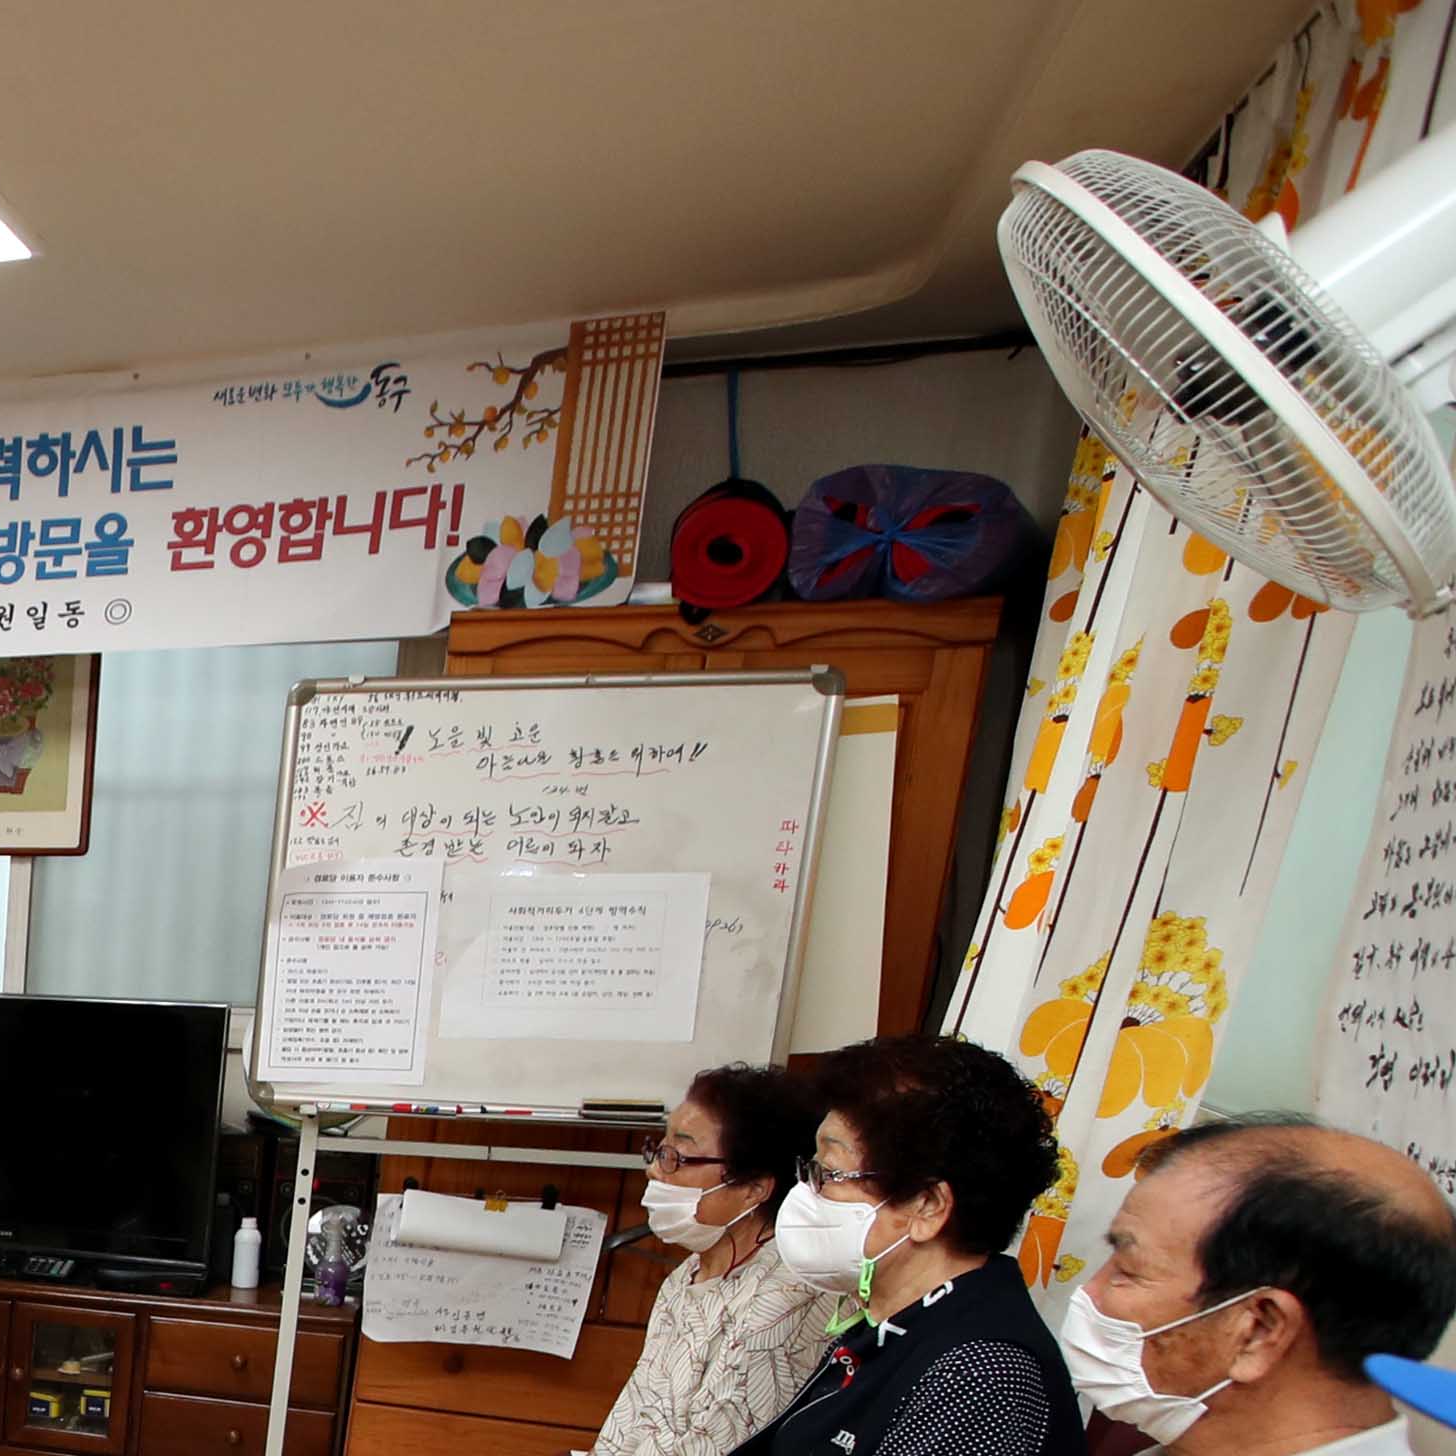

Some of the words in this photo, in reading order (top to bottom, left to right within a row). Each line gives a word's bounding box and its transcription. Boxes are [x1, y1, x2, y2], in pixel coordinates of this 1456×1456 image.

[370, 362, 411, 413] 동구
[167, 483, 465, 572] 환영합니다!
[428, 725, 465, 752] 노을
[508, 721, 542, 744] 고운
